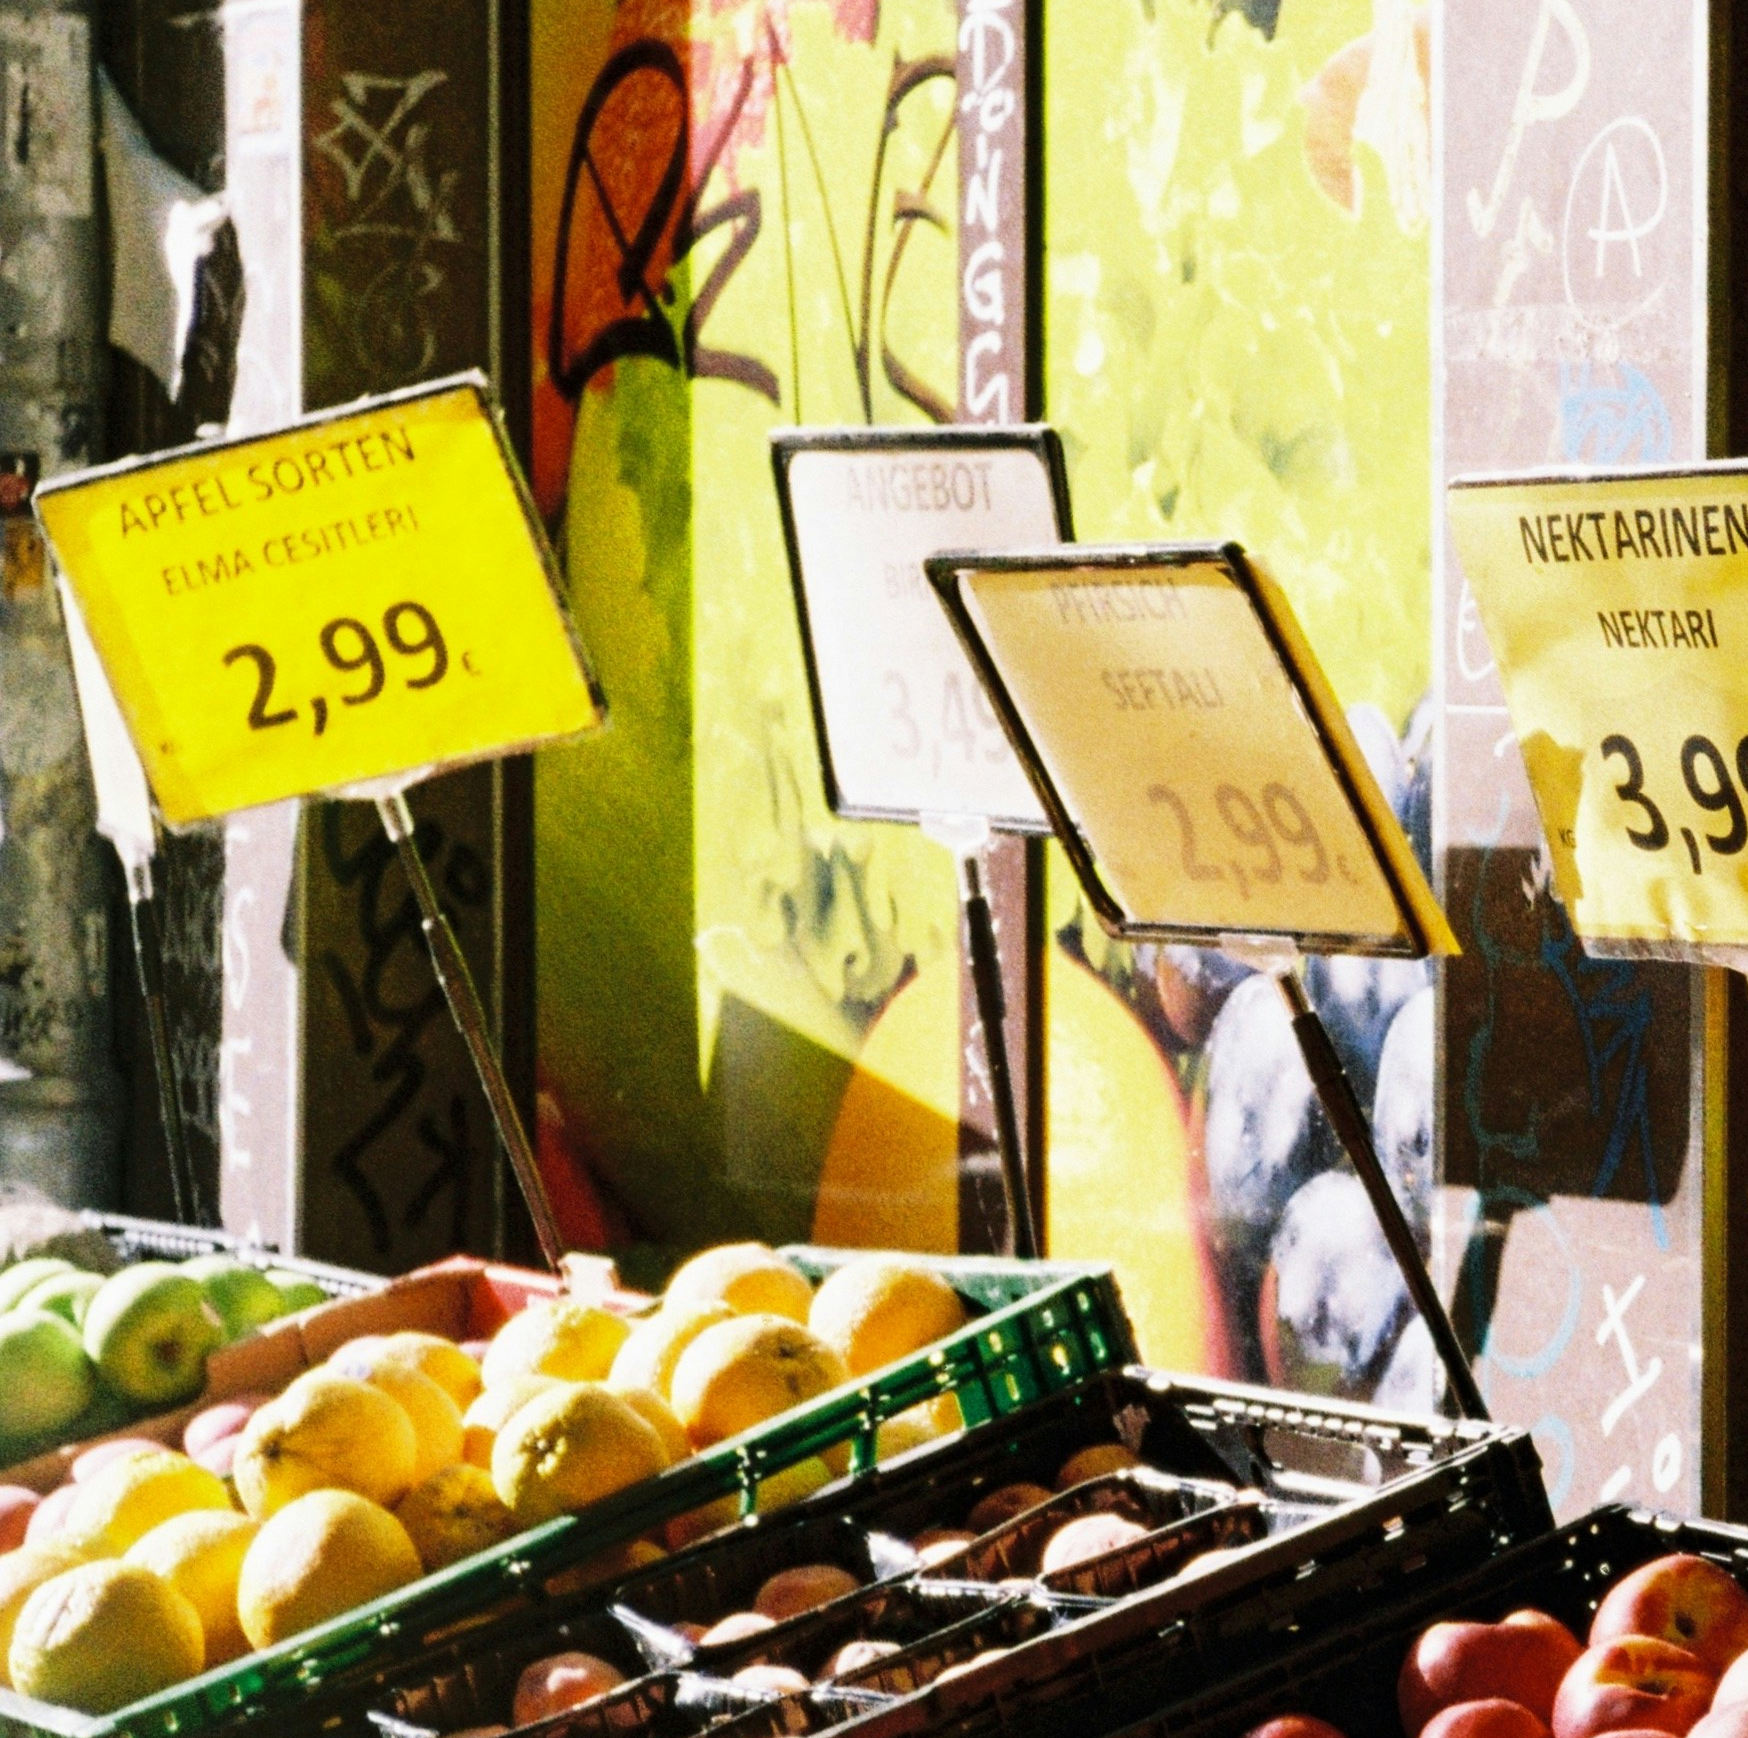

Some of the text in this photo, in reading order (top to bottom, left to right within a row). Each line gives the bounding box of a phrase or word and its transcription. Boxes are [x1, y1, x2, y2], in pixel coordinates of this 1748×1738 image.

[117, 425, 417, 540] APFEL SORTEN
[846, 463, 993, 512] ANGEBOT
[163, 548, 256, 596] ELMA
[1597, 607, 1720, 650] NEKTARI
[1101, 668, 1225, 711] SEFTALI
